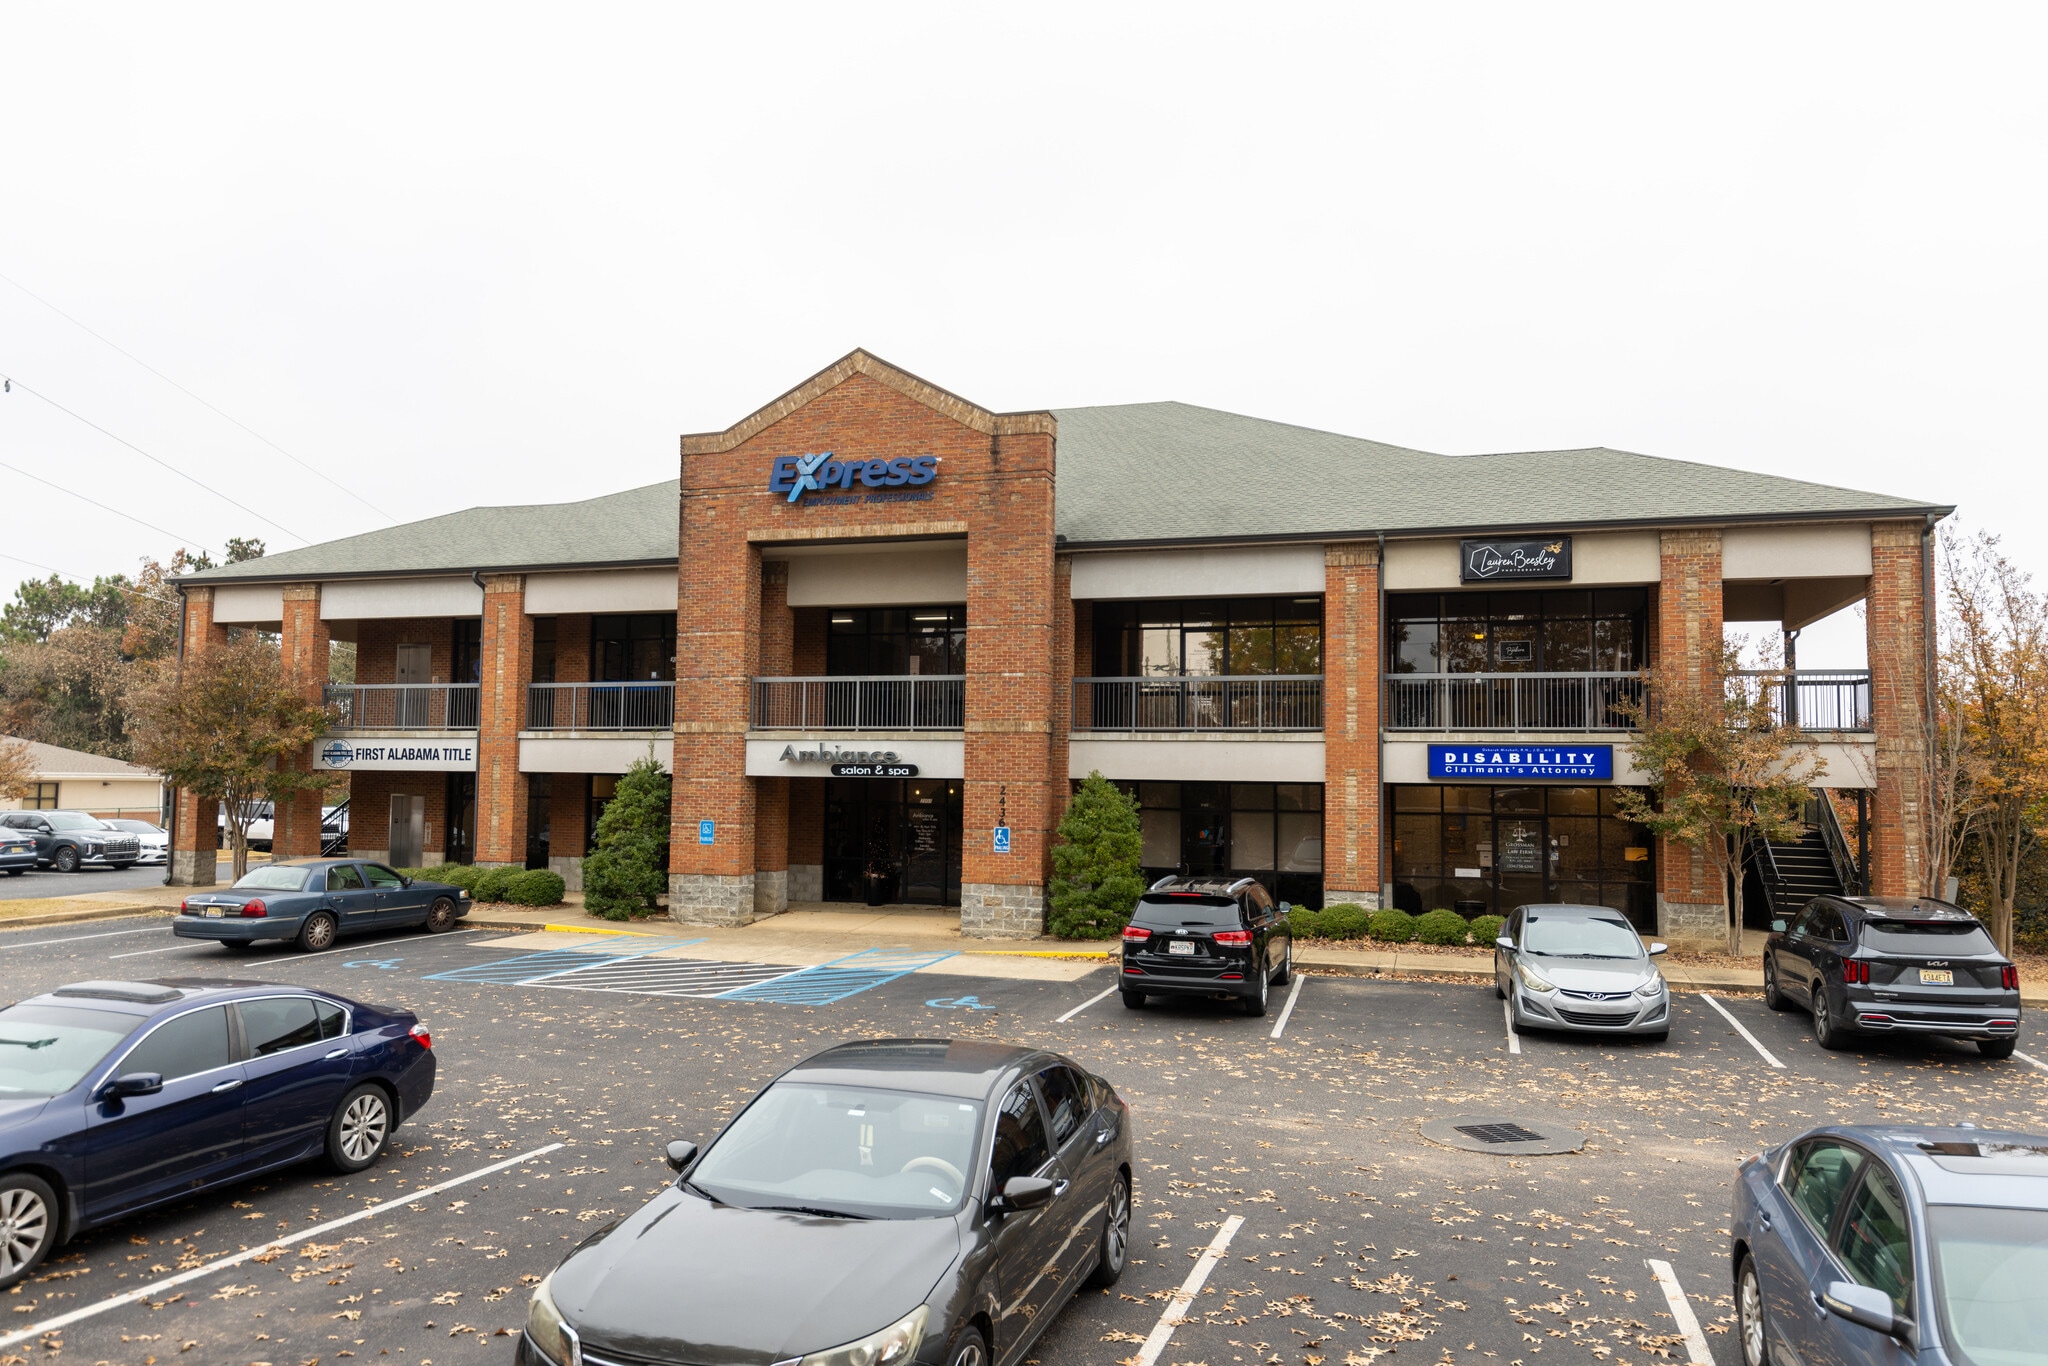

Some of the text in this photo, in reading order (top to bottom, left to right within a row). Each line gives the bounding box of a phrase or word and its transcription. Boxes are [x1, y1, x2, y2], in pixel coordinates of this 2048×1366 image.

[803, 491, 934, 507] EMPLOYMENT PROFESSIONALS
[1481, 549, 1556, 572] Lauren Beesley
[355, 747, 472, 761] FIRST ALABAMA TITLE
[779, 742, 901, 763] Ambiance
[1445, 753, 1595, 764] DISABILITY
[840, 765, 910, 776] salon & spa
[1532, 766, 1595, 775] Attorney
[998, 785, 1006, 827] 2436
